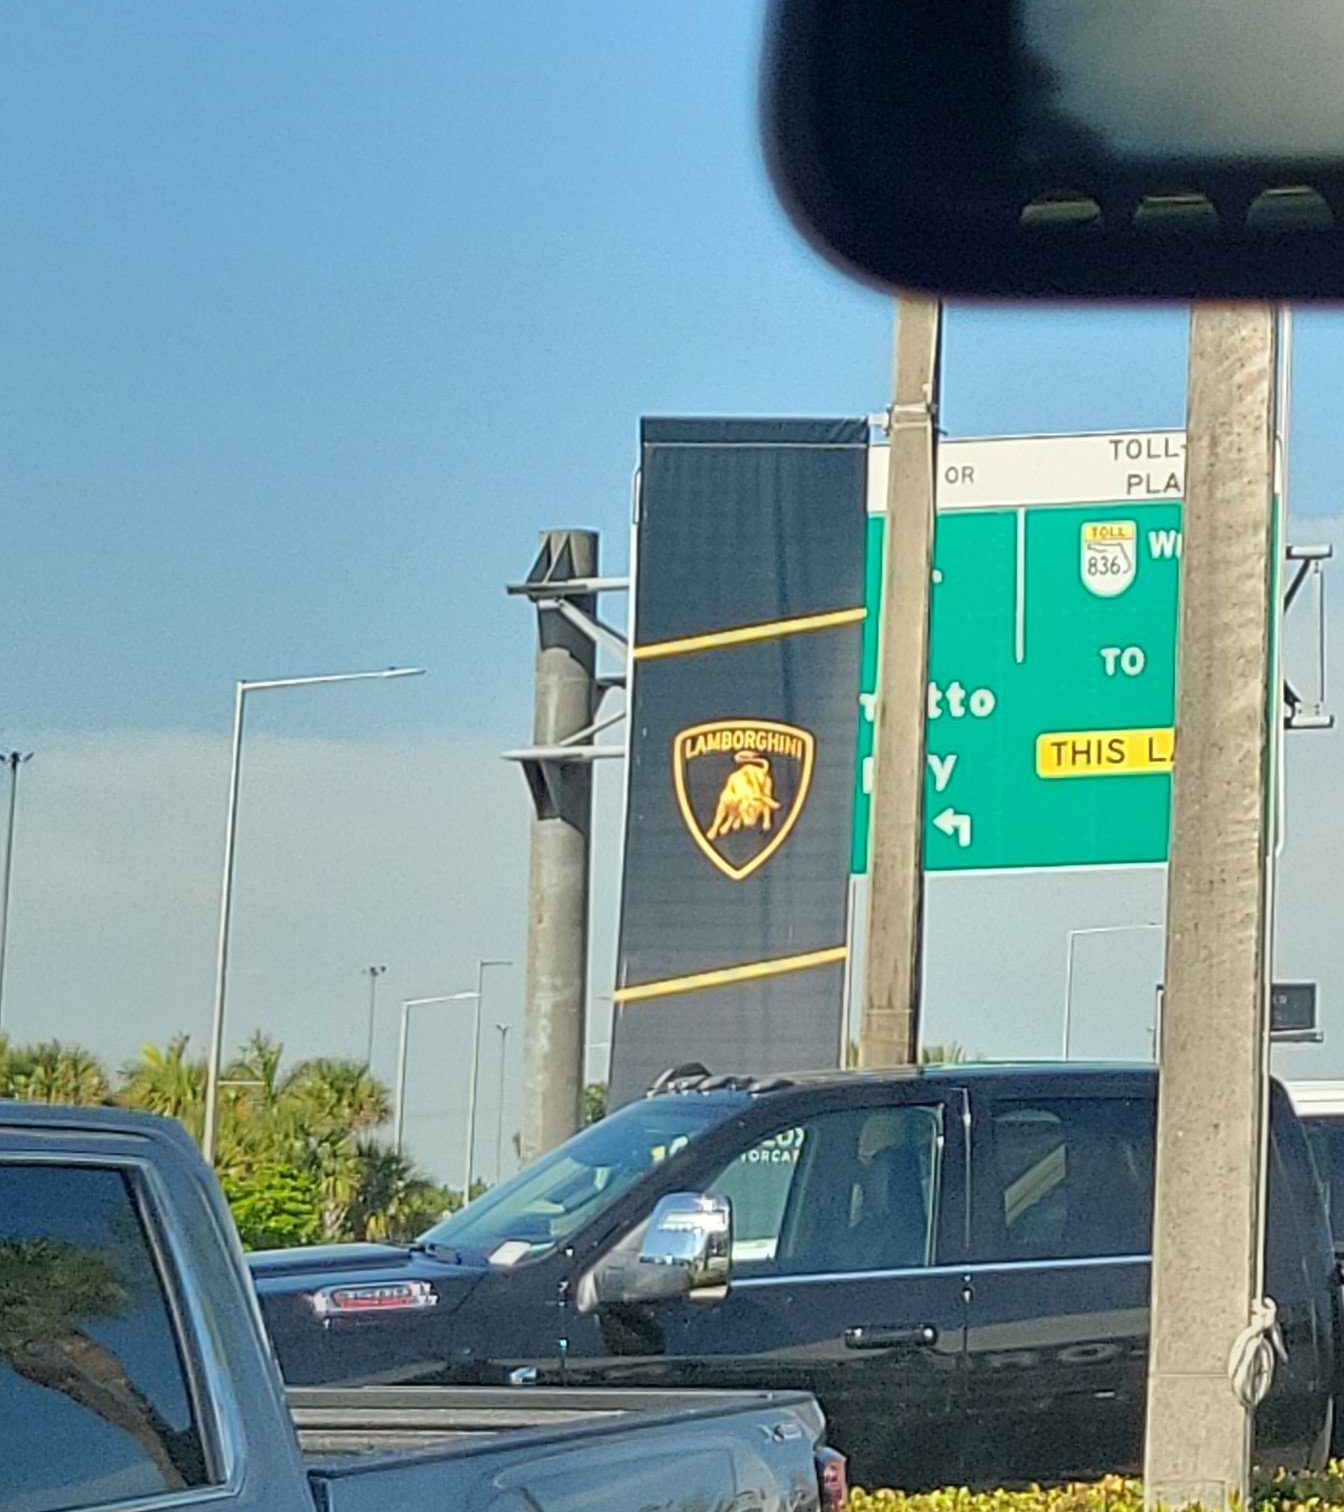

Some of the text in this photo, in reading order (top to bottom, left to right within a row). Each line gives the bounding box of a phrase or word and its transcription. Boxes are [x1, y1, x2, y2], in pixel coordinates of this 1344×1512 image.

[944, 466, 975, 484] OR
[1126, 472, 1182, 496] PLA
[1090, 526, 1126, 538] TOLL
[1148, 529, 1183, 559] W
[1087, 557, 1121, 576] 836
[1100, 646, 1146, 677] TO
[685, 729, 803, 760] LAMBORGHINI
[1050, 736, 1176, 767] THIS L
